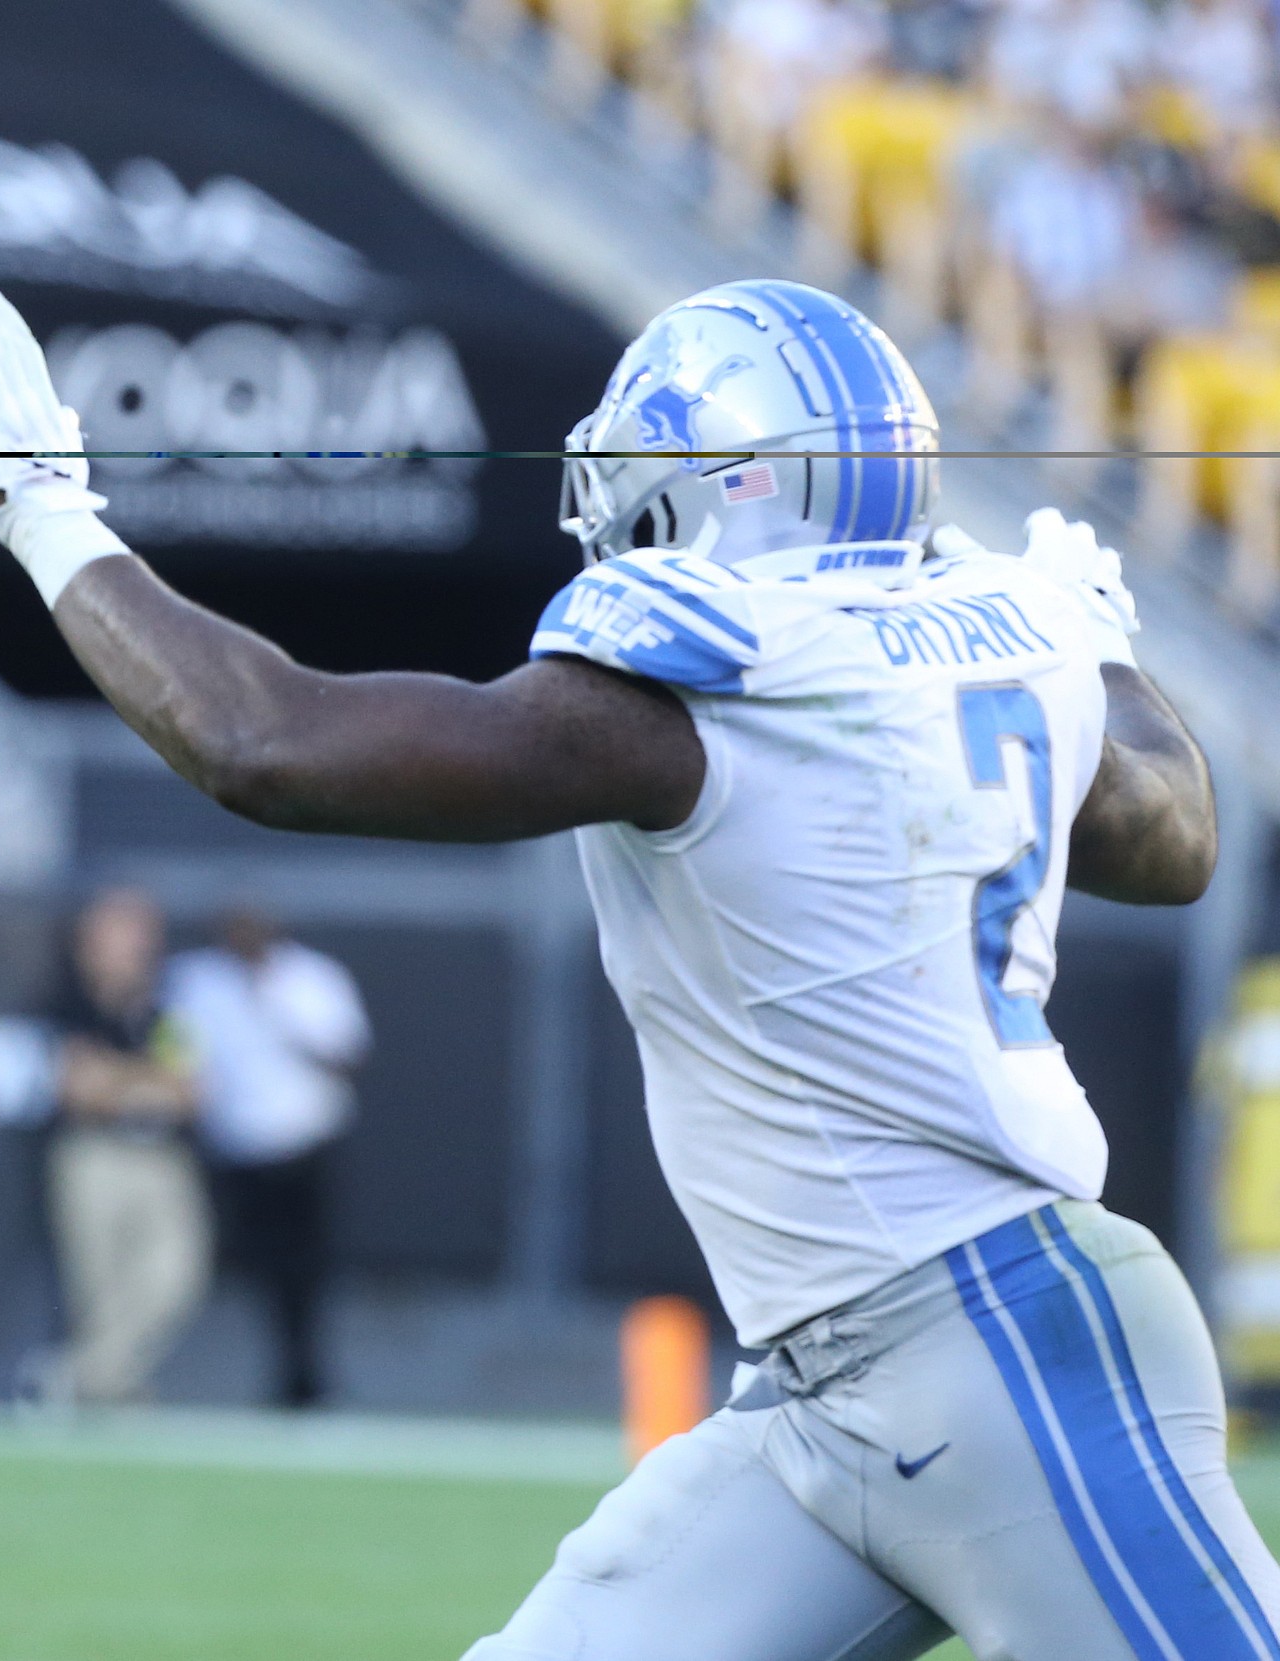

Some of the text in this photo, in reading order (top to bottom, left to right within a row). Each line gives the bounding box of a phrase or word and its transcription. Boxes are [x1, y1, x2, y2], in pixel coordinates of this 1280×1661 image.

[562, 584, 675, 651] WCF
[866, 592, 1055, 665] BRYANT
[956, 679, 1057, 1049] 2
